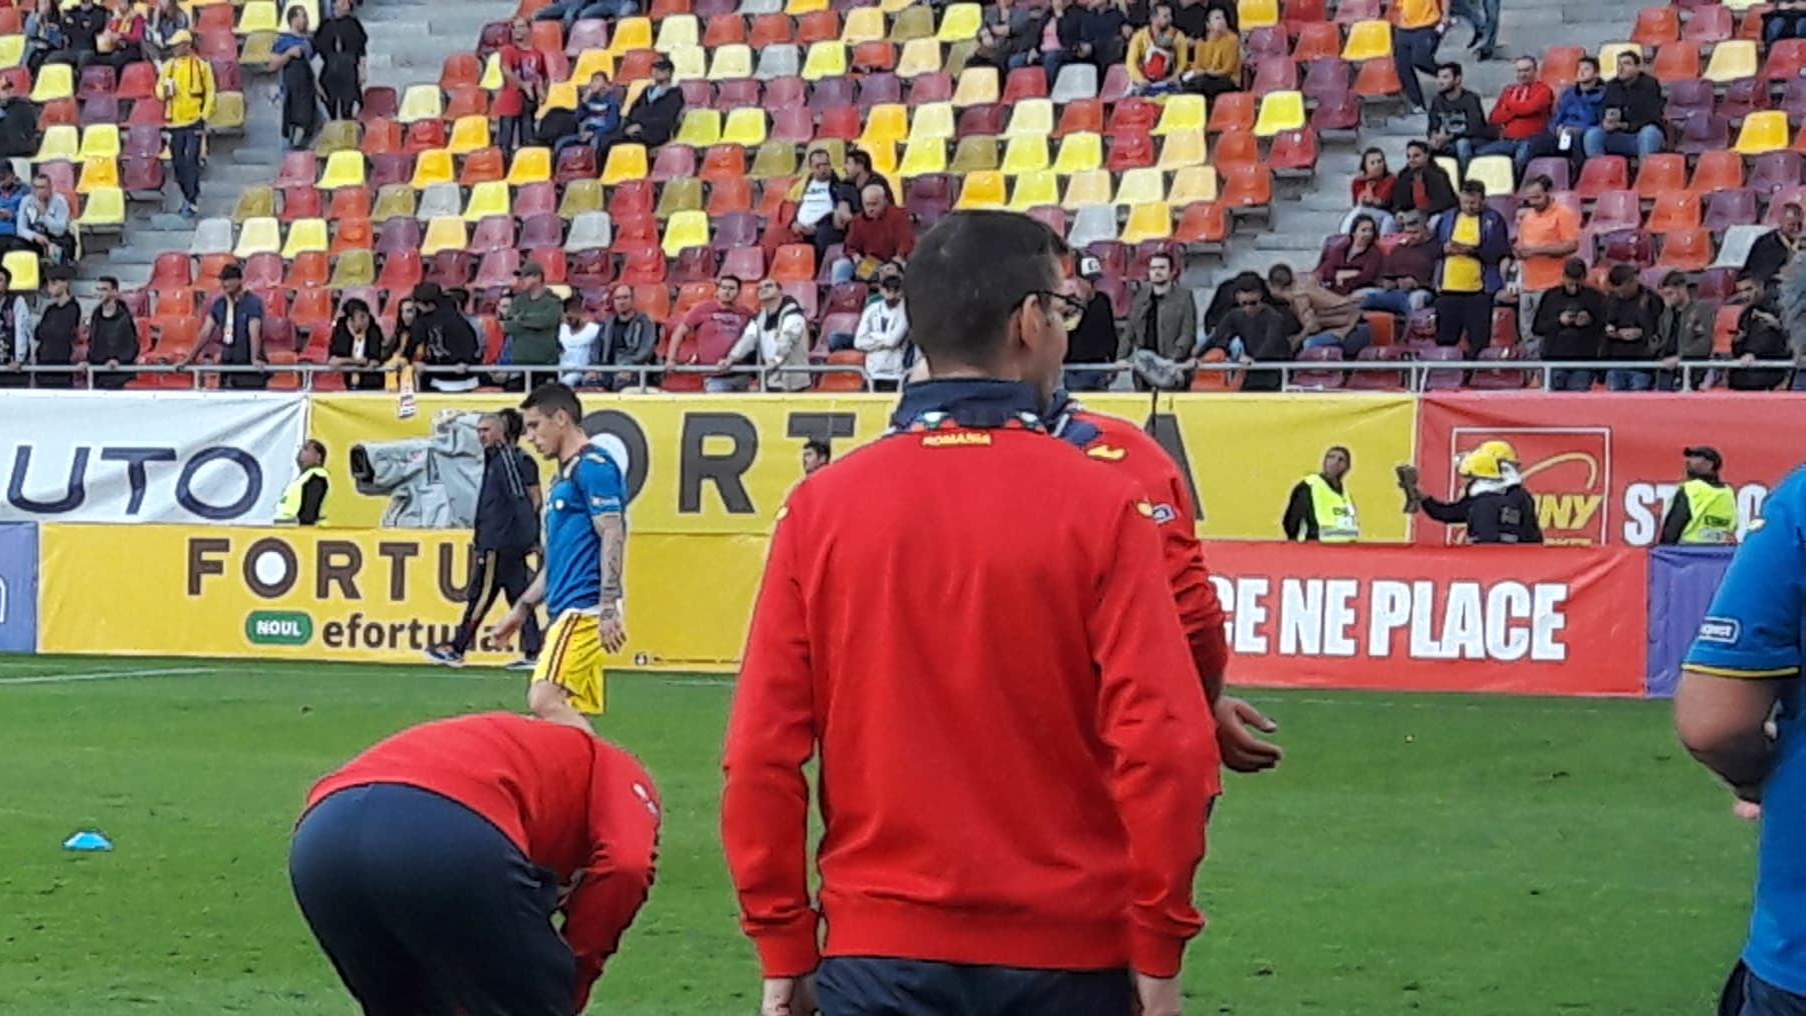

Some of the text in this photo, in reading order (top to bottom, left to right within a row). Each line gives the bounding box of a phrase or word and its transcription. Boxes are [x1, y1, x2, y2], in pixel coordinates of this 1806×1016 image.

[187, 537, 473, 603] FORTU
[255, 620, 302, 637] NOUL
[1279, 578, 1358, 655] NE
[1368, 580, 1568, 660] PLACE
